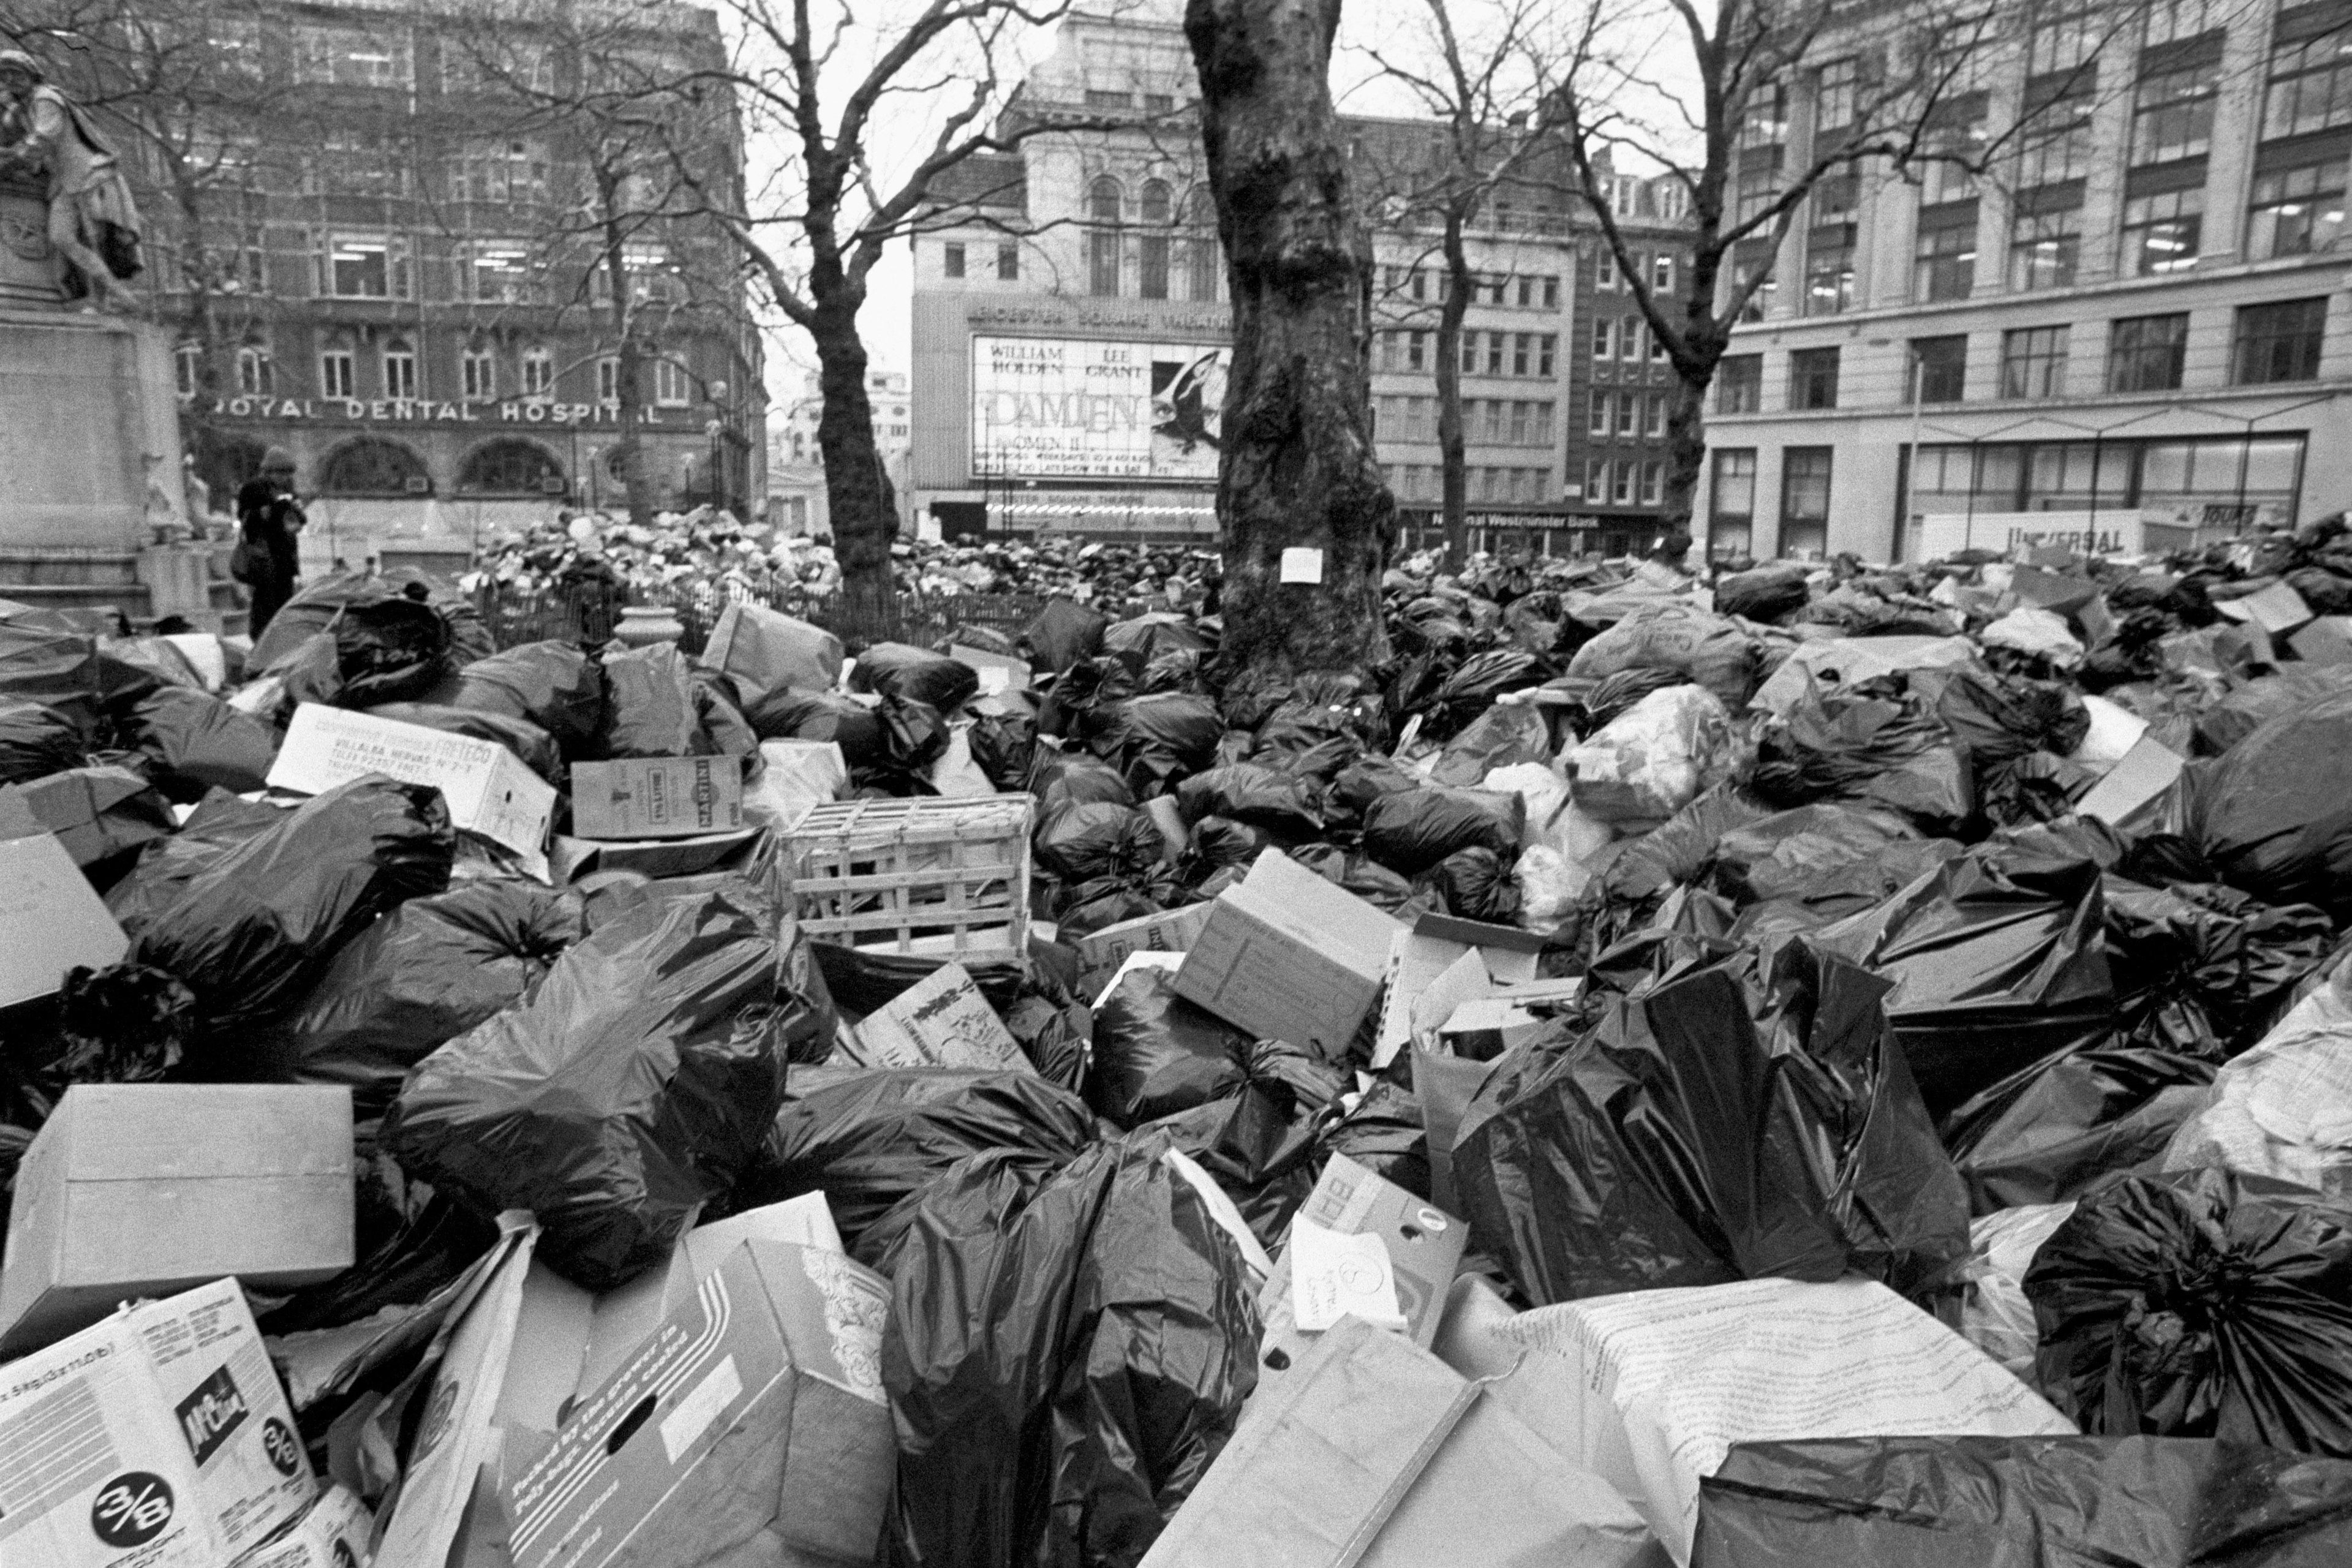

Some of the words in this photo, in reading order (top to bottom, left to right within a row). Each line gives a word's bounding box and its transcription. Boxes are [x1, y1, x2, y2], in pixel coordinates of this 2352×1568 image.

[990, 344, 1063, 361] WILLIAM
[992, 361, 1063, 375] HOLDEN
[1085, 366, 1142, 379] GRANT
[1103, 349, 1129, 363] LEE
[346, 401, 479, 421] DENTAL
[982, 391, 1139, 432] DAMIEN
[696, 760, 712, 827] MARTINI
[641, 1330, 688, 1382] cooled
[512, 1442, 559, 1498] Packed
[561, 1423, 579, 1446] by
[582, 1397, 606, 1425] the
[607, 1343, 658, 1401] grower
[660, 1325, 677, 1343] in
[265, 1425, 297, 1465] 3/8
[94, 1482, 173, 1532] 3/8
